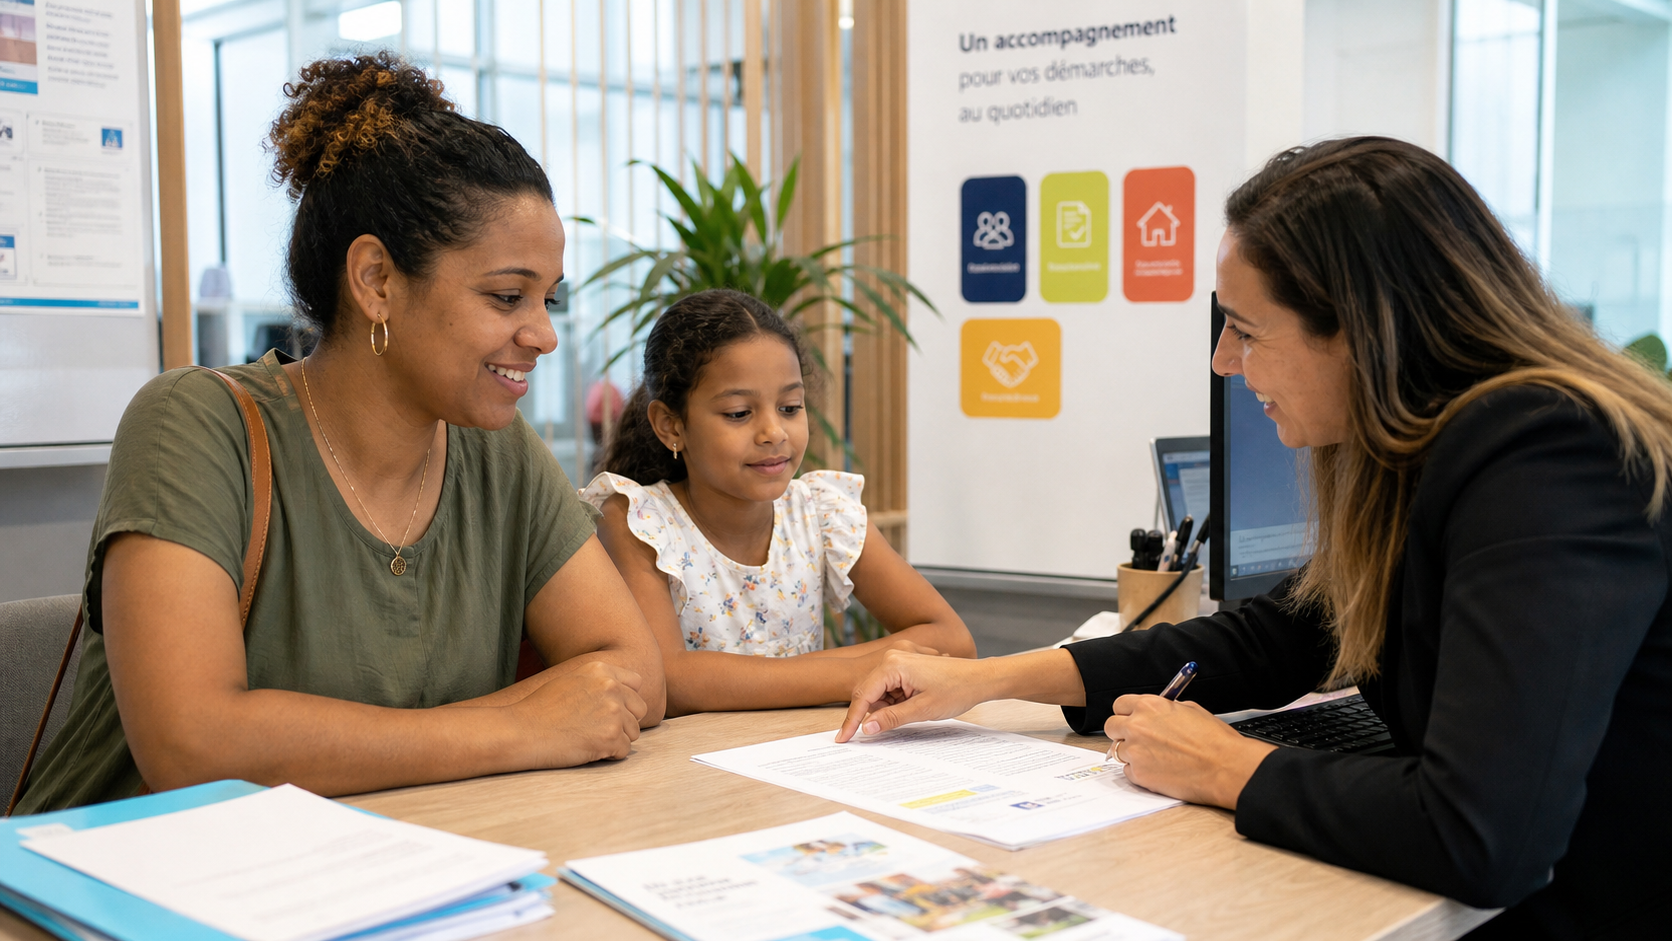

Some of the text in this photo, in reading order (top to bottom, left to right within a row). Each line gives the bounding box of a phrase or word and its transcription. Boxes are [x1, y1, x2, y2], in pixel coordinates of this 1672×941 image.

[959, 15, 1177, 53] Un accompagnement
[959, 55, 1156, 92] pour vos démarches,
[958, 96, 1078, 125] au quotidien
